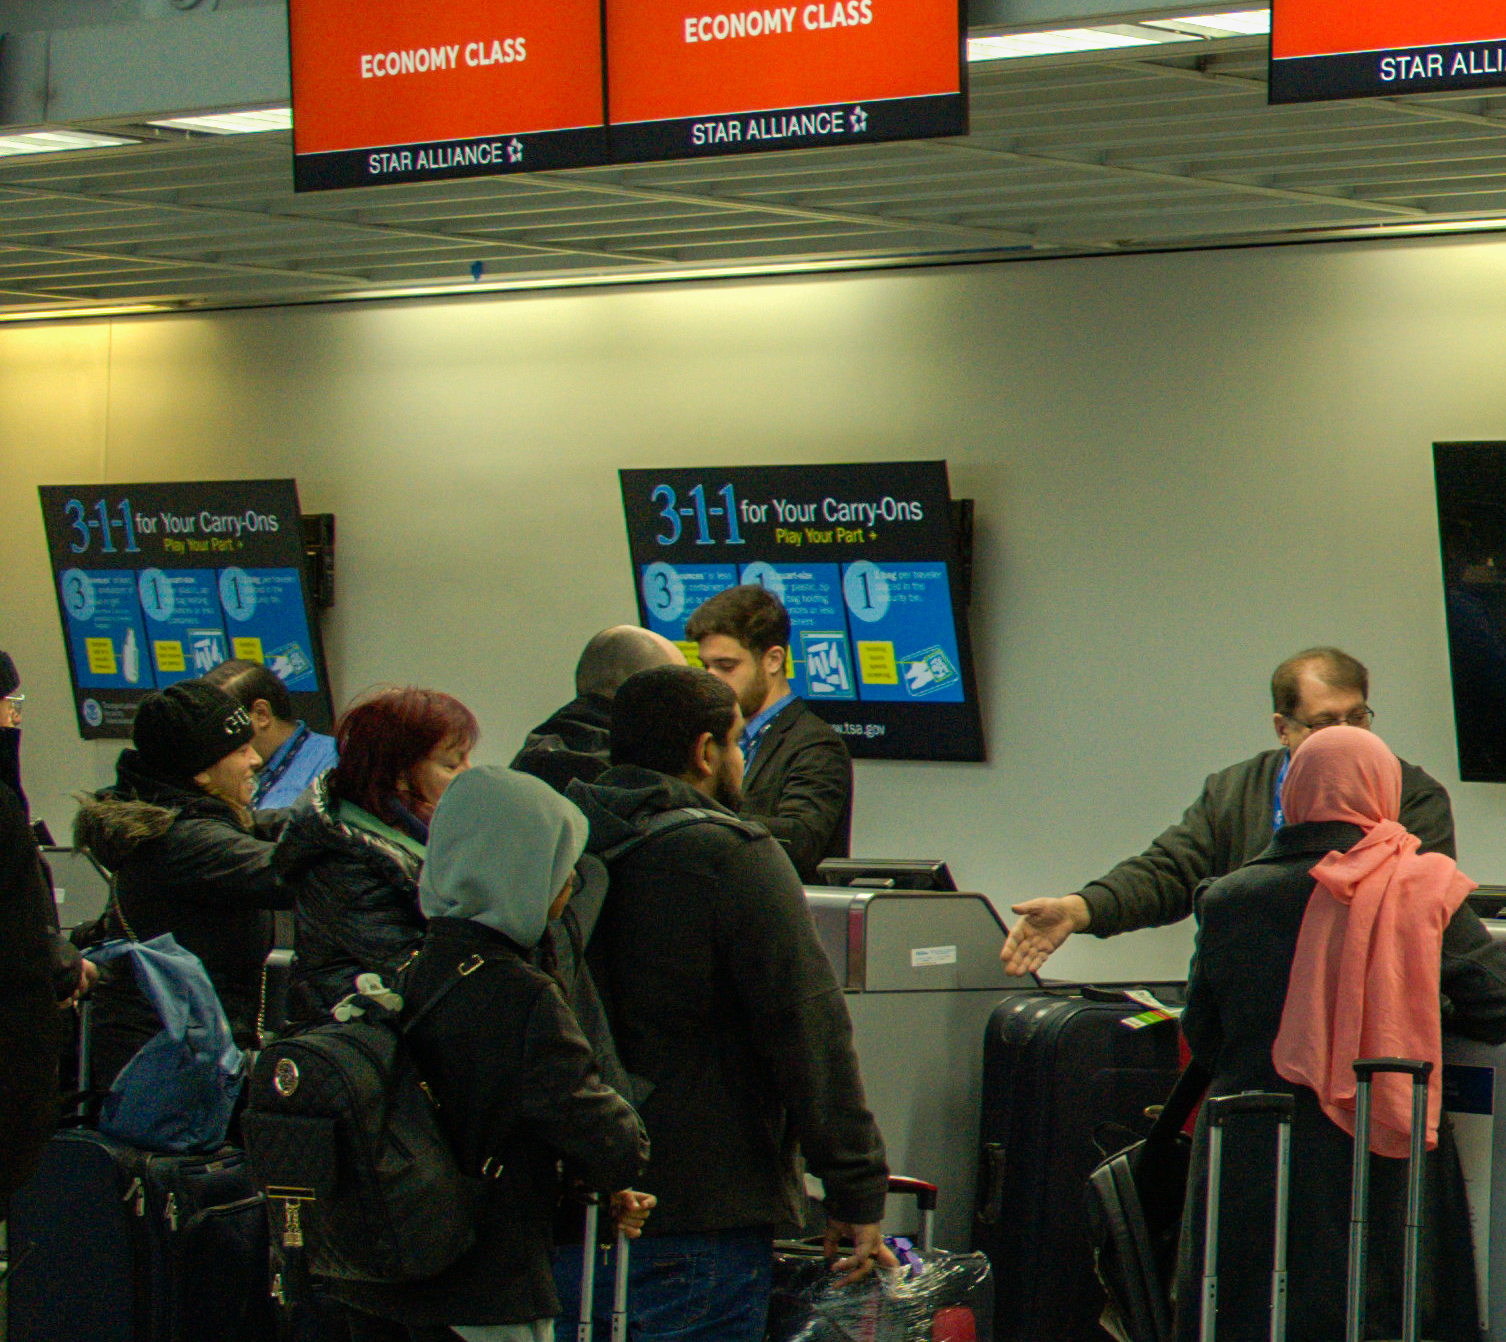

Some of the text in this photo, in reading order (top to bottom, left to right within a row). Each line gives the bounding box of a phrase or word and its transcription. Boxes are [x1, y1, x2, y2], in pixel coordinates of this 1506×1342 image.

[684, 7, 795, 44] ECONOMY
[361, 37, 527, 79] ECONOMY CLASS
[1379, 54, 1445, 82] STAR
[691, 111, 844, 146] STAR ALLIANCE
[369, 143, 502, 176] STAR ALLIANCE
[65, 499, 279, 554] 3-1-1 for Your Carry-Ons
[651, 483, 923, 545] 3-1-1 for Your Carry-Ons
[164, 538, 233, 554] Play Your Part
[775, 528, 865, 546] Play Your Part
[69, 578, 86, 609] 3
[151, 577, 163, 609] 1
[232, 577, 243, 609] 1
[653, 572, 673, 609] 3
[857, 572, 874, 609] 1
